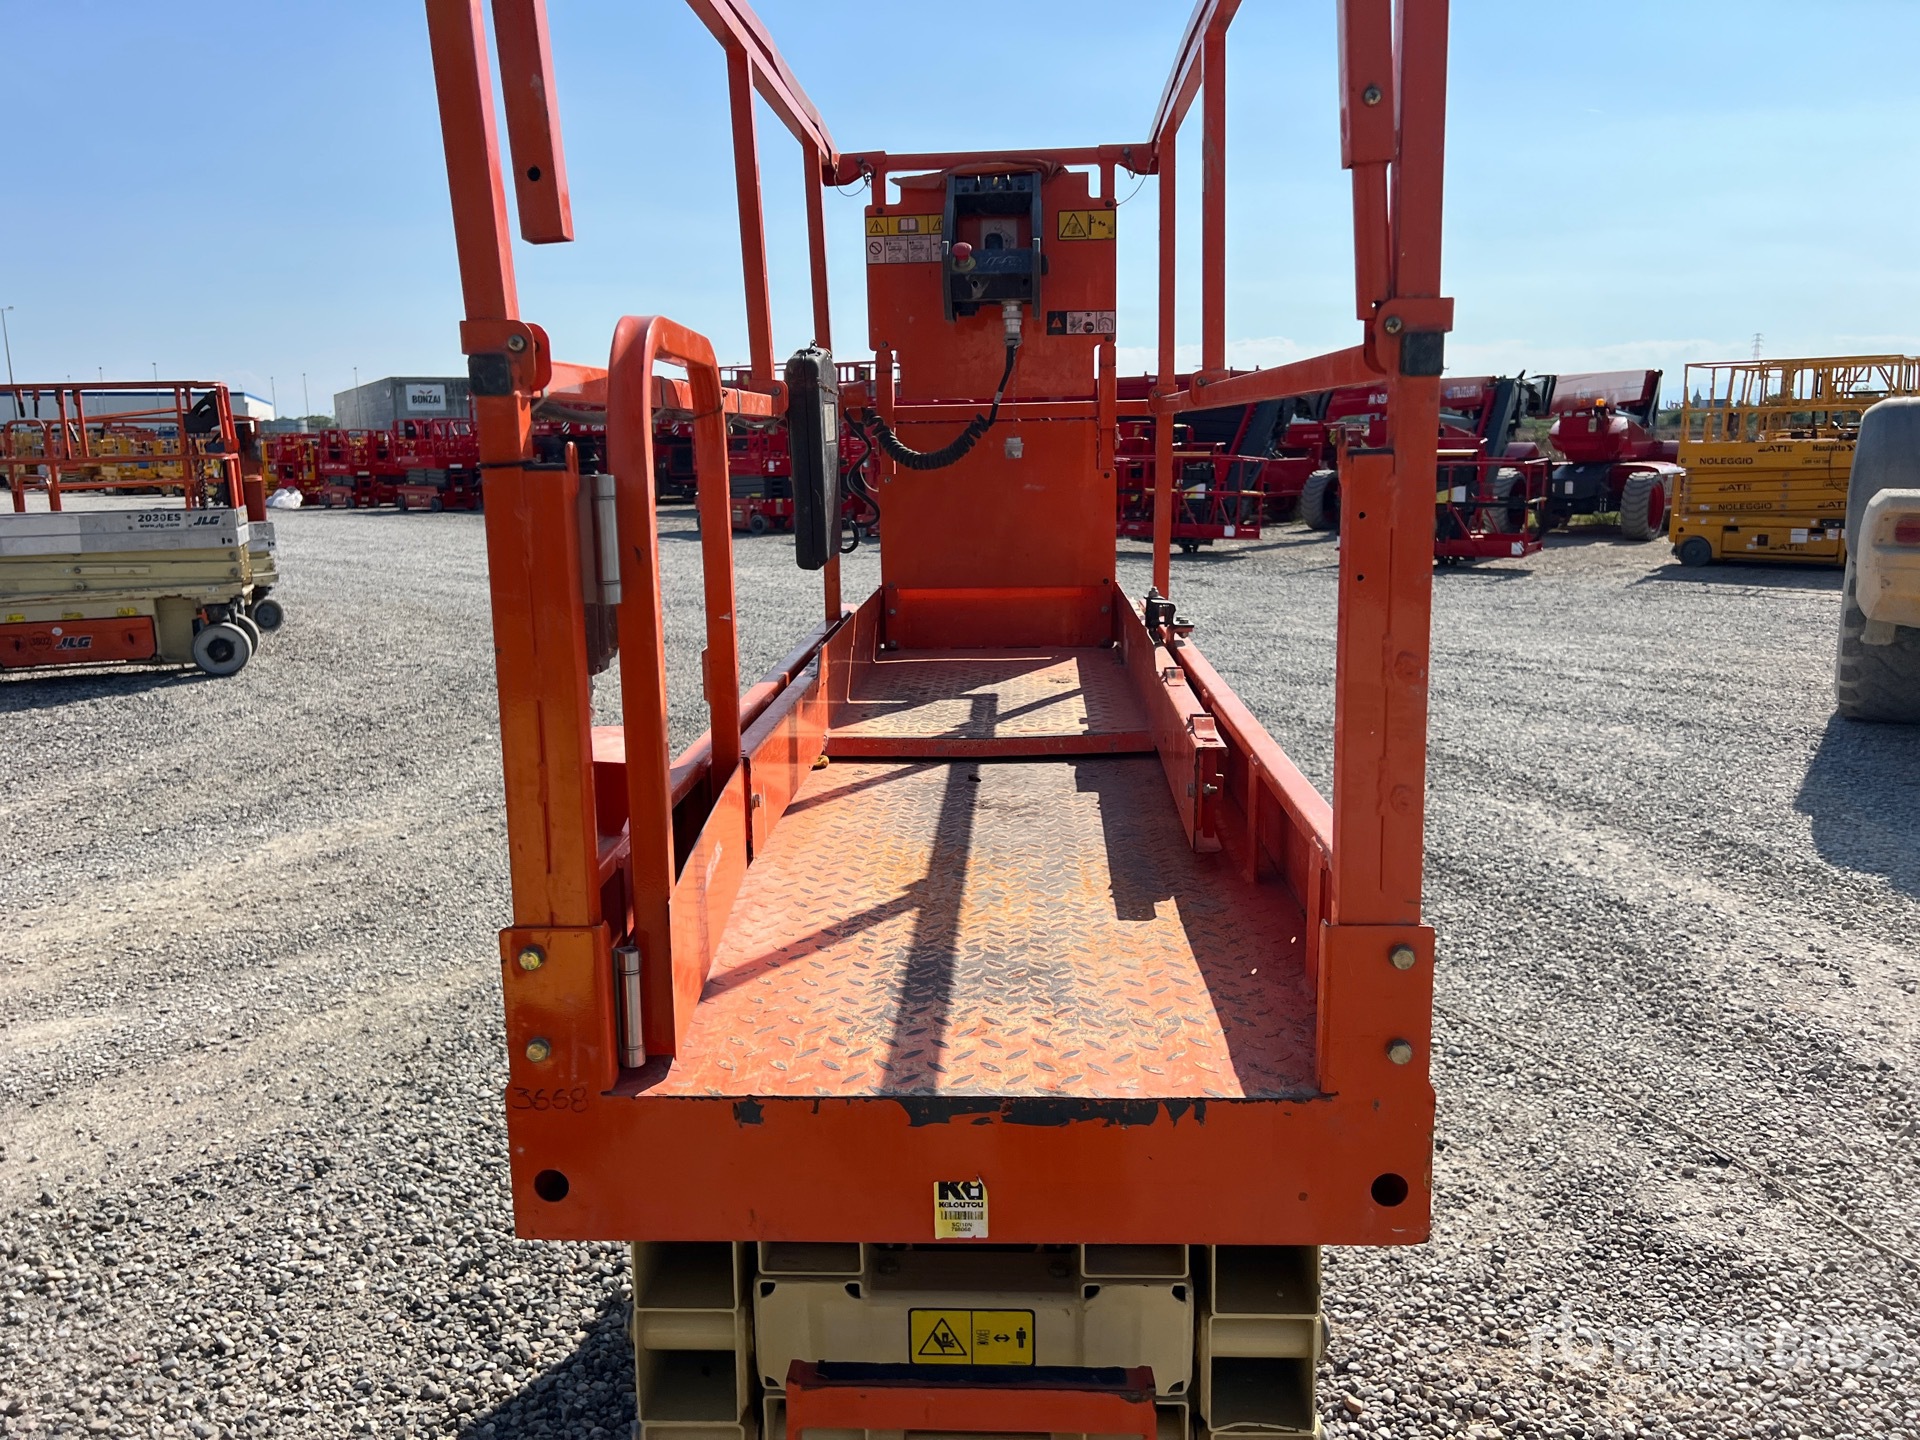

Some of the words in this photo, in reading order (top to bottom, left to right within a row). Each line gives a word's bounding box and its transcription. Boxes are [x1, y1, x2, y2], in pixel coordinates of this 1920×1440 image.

[412, 394, 441, 404] BONZAI
[1699, 457, 1754, 466] NOLEGGIO
[1718, 502, 1773, 511] NOLEGGIO
[137, 513, 182, 523] 2030ES
[193, 515, 221, 526] JLG
[54, 635, 94, 650] JLG
[511, 1087, 589, 1113] 3668
